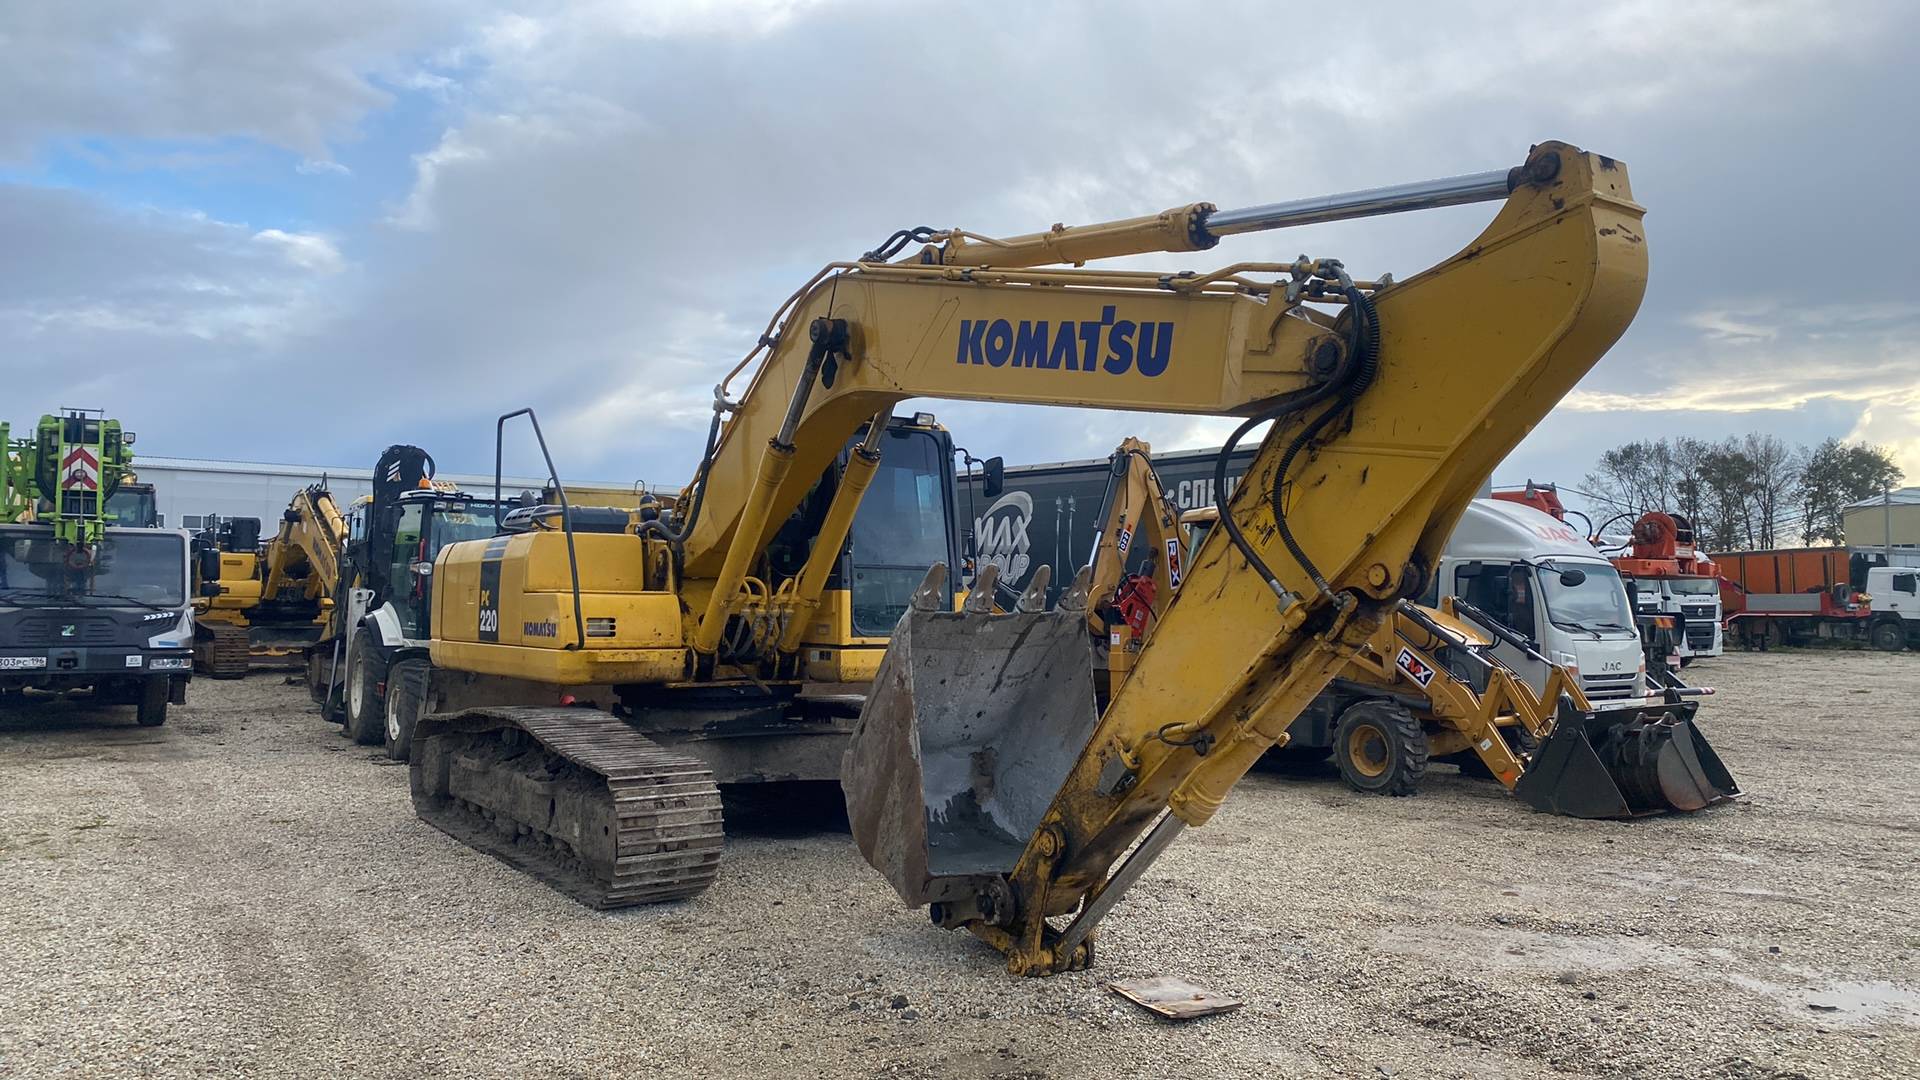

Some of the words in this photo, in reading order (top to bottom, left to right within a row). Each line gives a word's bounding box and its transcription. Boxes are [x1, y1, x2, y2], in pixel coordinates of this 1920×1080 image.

[957, 305, 1174, 377] KOMATSU
[974, 515, 1031, 555] MAX
[1536, 526, 1579, 543] JAC
[1168, 542, 1181, 583] RMX
[481, 590, 490, 607] PC
[479, 609, 498, 632] 220
[523, 618, 557, 638] KOMATSU
[1398, 652, 1432, 683] RMX
[1601, 661, 1622, 672] JAC
